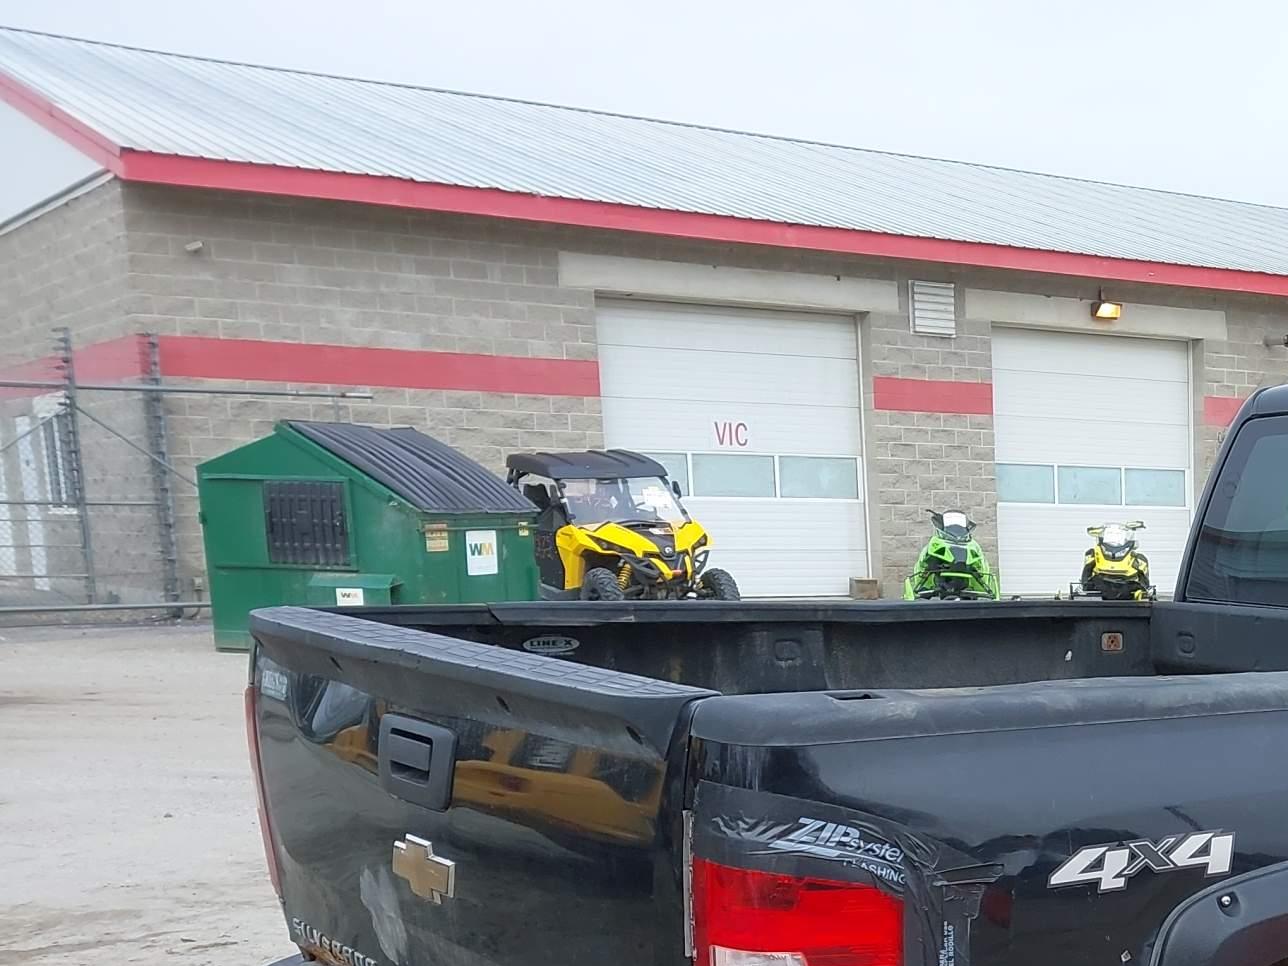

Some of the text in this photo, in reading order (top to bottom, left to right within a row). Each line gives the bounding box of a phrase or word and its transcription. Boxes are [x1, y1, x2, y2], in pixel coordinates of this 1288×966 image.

[713, 421, 748, 447] VIC
[469, 542, 495, 556] WM
[786, 816, 861, 848] ZIP
[843, 858, 905, 885] ASHIN
